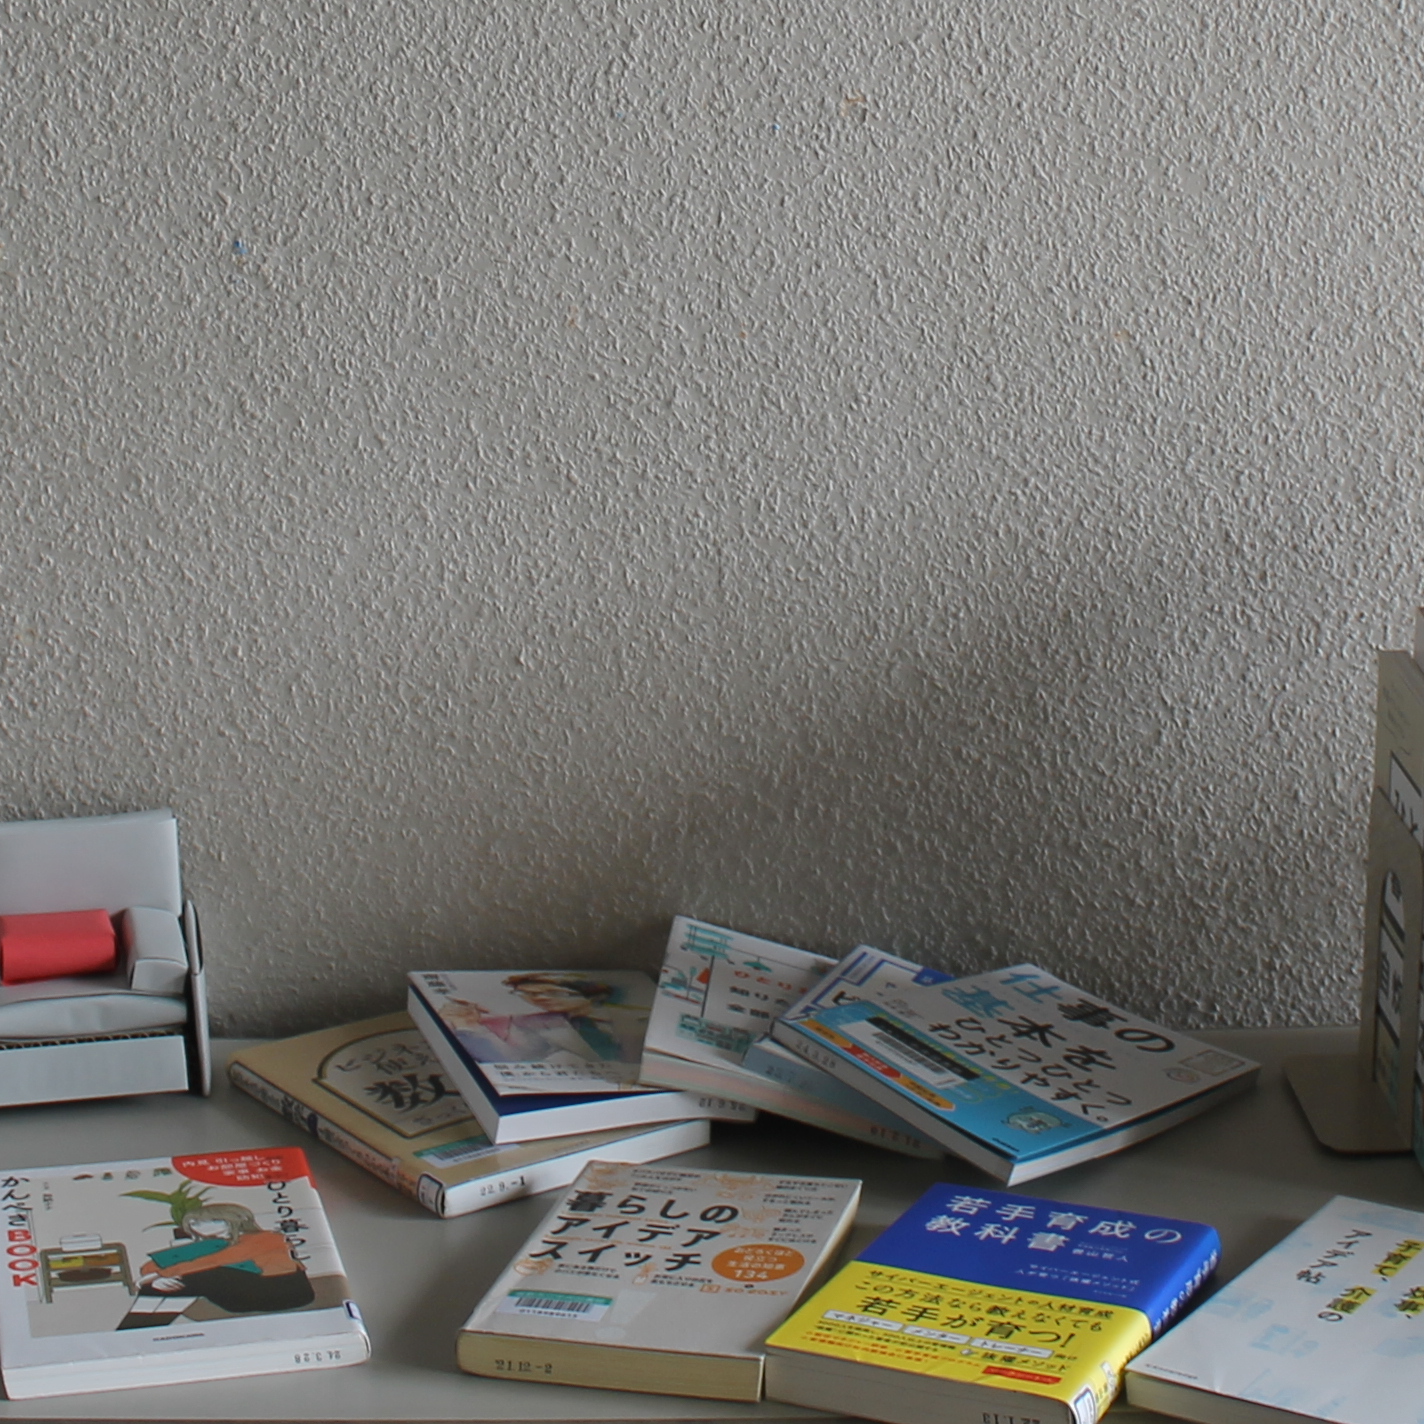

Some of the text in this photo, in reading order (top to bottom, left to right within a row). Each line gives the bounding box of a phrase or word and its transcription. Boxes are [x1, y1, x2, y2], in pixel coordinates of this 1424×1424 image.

[943, 987, 1114, 1071] 基本を
[1002, 970, 1174, 1053] 仕事の
[929, 1023, 1106, 1121] わかりやすく。
[954, 1016, 1132, 1106] ひとつひとつ
[0, 1175, 40, 1287] かんぺきBOOK
[266, 1179, 312, 1262] ひとり暮らし
[551, 1215, 720, 1247] アイデア
[568, 1190, 738, 1224] 暮らしの
[925, 1214, 1067, 1251] 教科書
[947, 1195, 1181, 1243] 若手育成の
[529, 1239, 701, 1272] スイッチ
[734, 1268, 768, 1279] 134
[1296, 1228, 1373, 1284] アイデア帖
[855, 1280, 1101, 1332] この方法なら教えなくても
[858, 1295, 1074, 1347] 若手が育つ!
